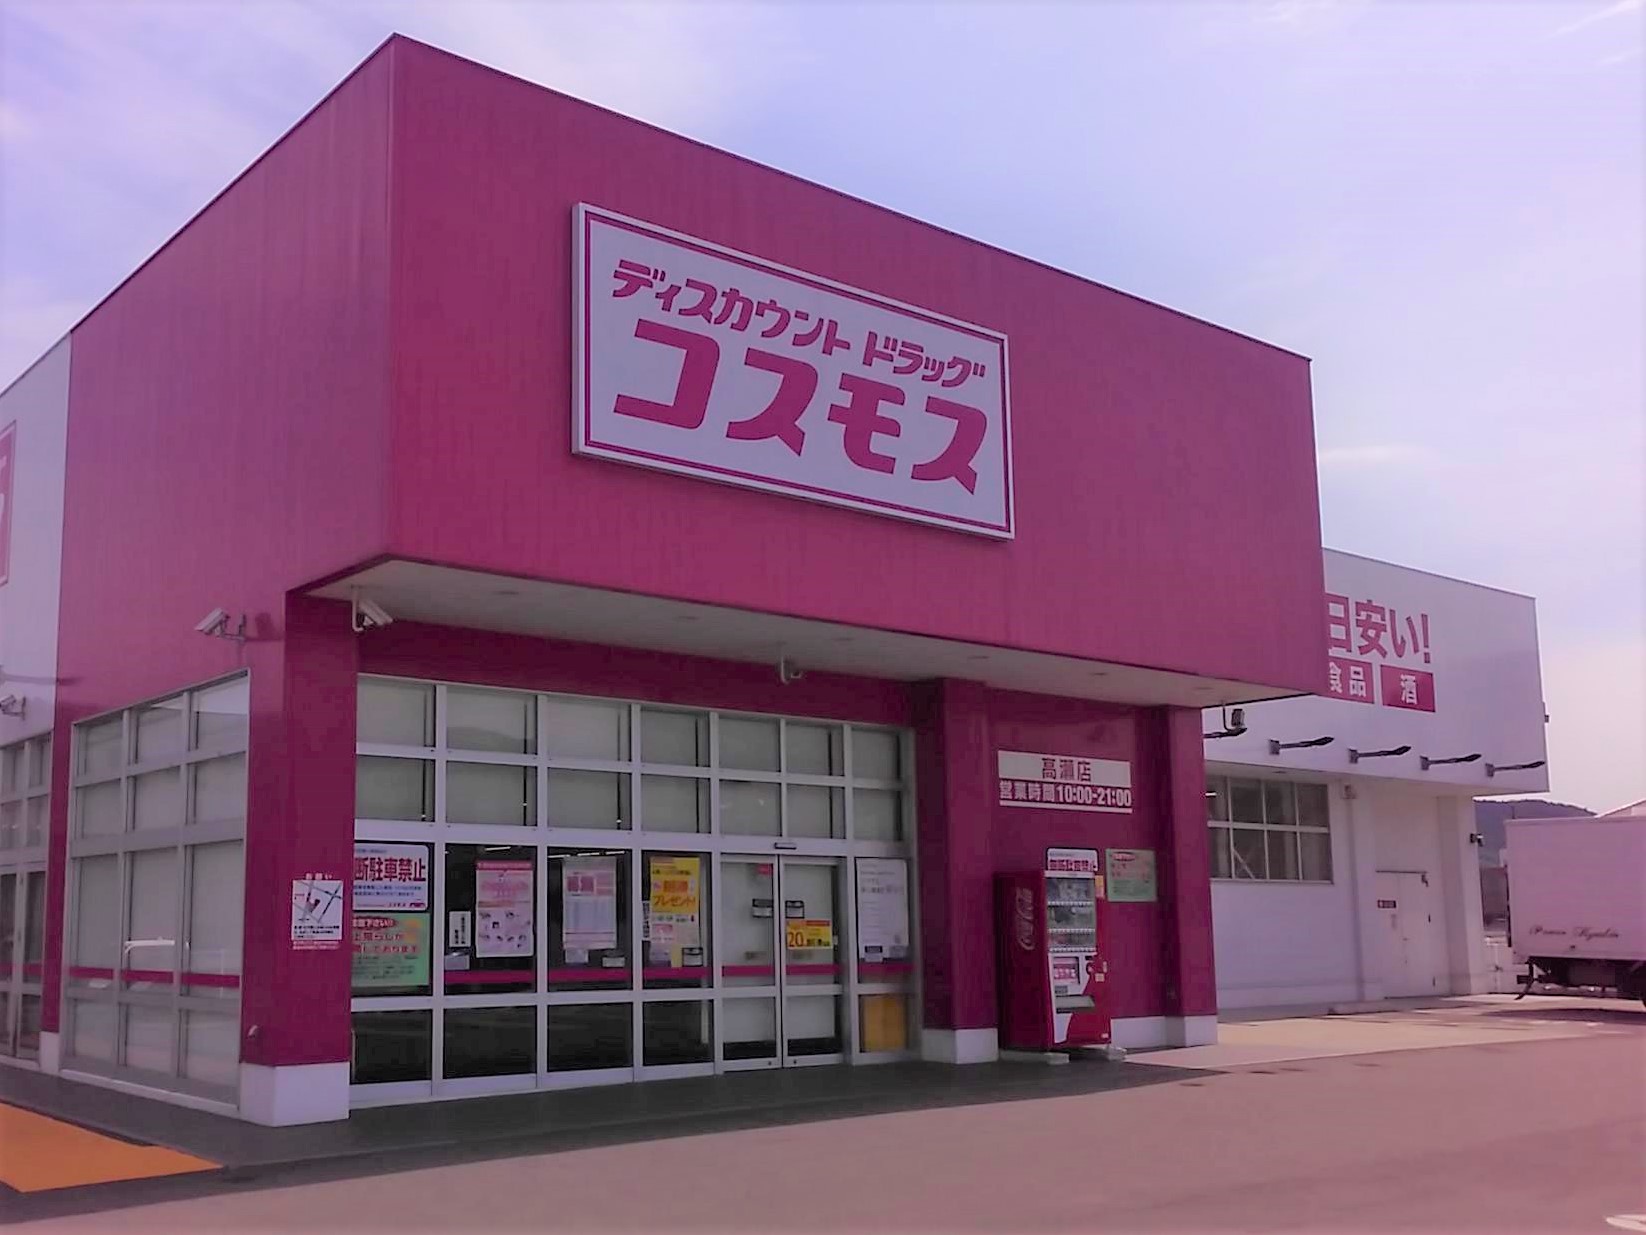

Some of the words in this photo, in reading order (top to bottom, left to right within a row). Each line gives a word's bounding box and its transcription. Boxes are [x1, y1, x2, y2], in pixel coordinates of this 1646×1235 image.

[612, 259, 850, 355] ディスカウント
[863, 331, 986, 388] ドラッグ
[613, 318, 988, 495] コスモス
[1400, 674, 1418, 705] 酒
